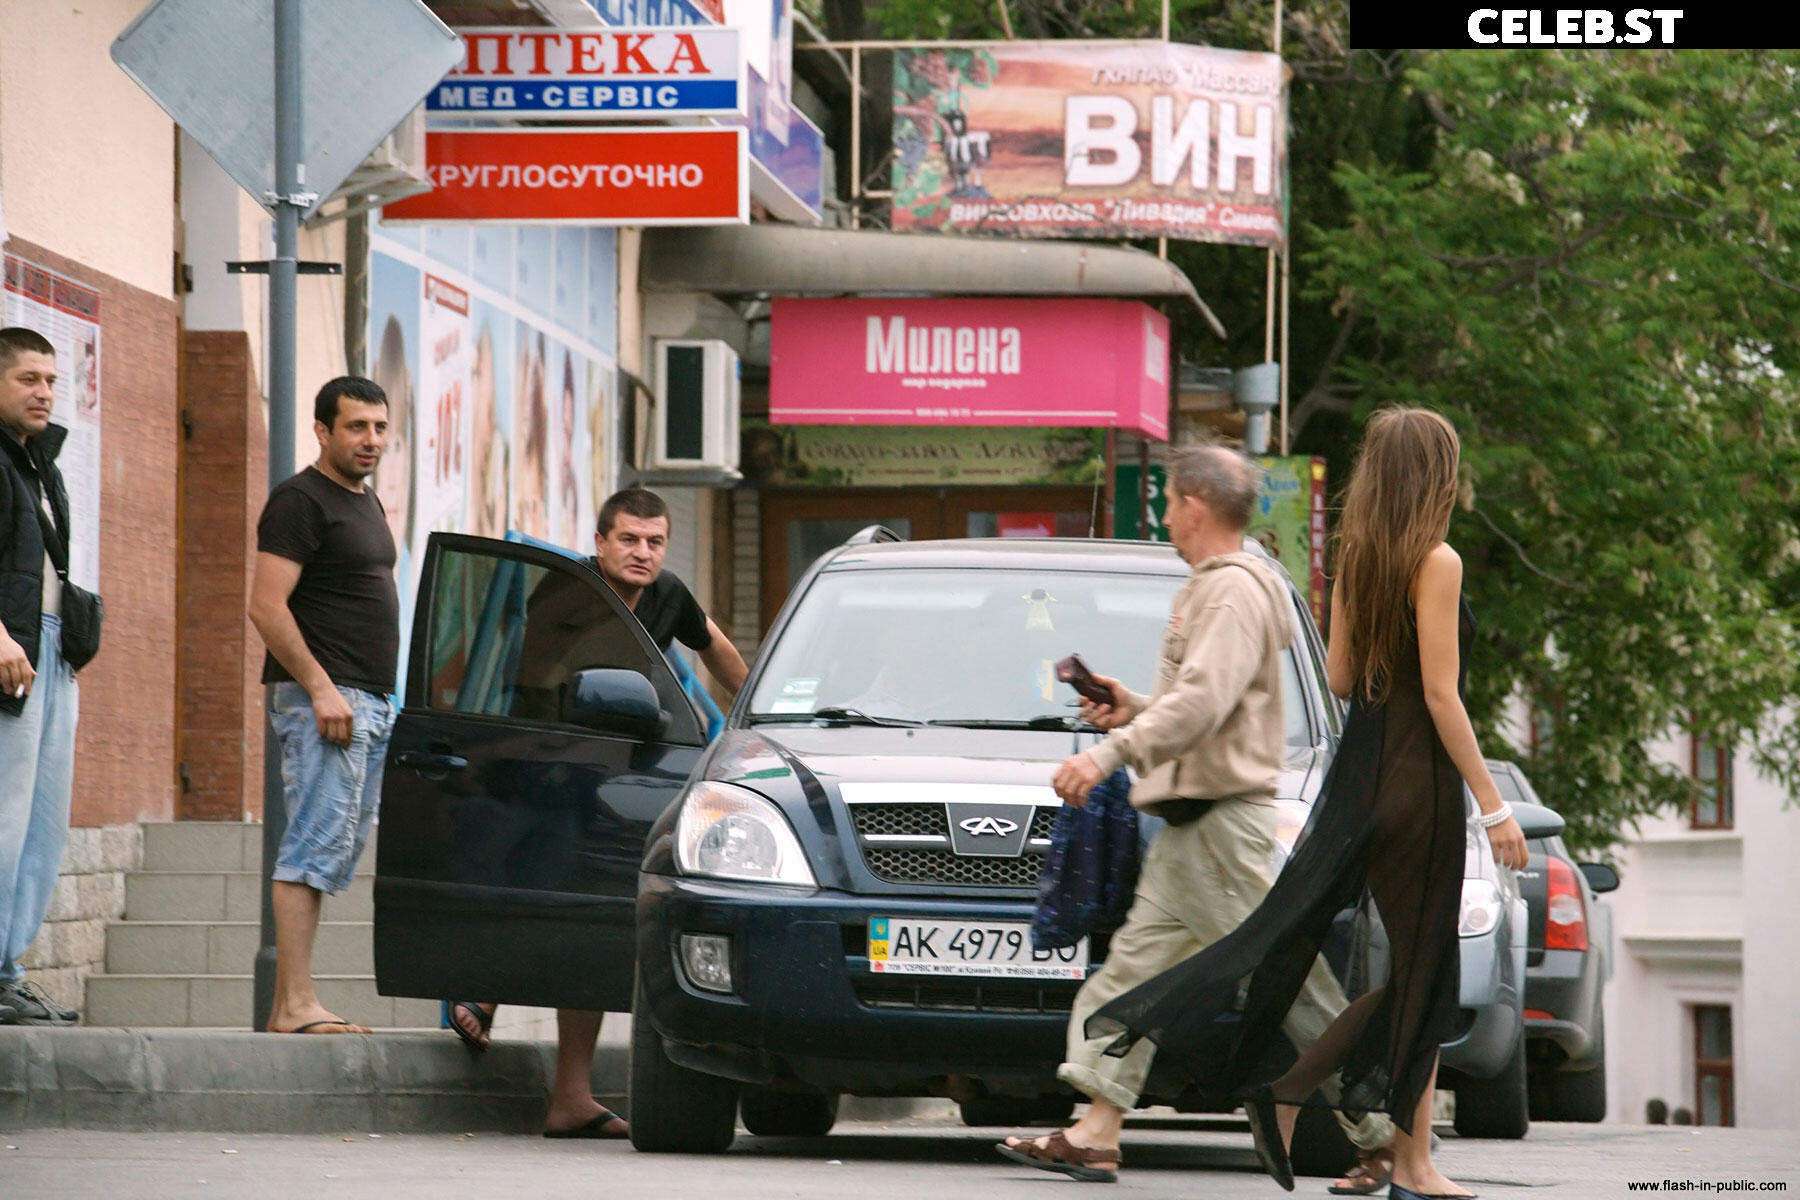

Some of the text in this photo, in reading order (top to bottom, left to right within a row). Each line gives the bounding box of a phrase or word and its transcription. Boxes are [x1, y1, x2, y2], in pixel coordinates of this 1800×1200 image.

[450, 33, 712, 76] ПТЕКА
[439, 85, 680, 108] МЕД СЕРВІС
[865, 315, 1021, 375] Милена
[948, 928, 1023, 961] 4979
